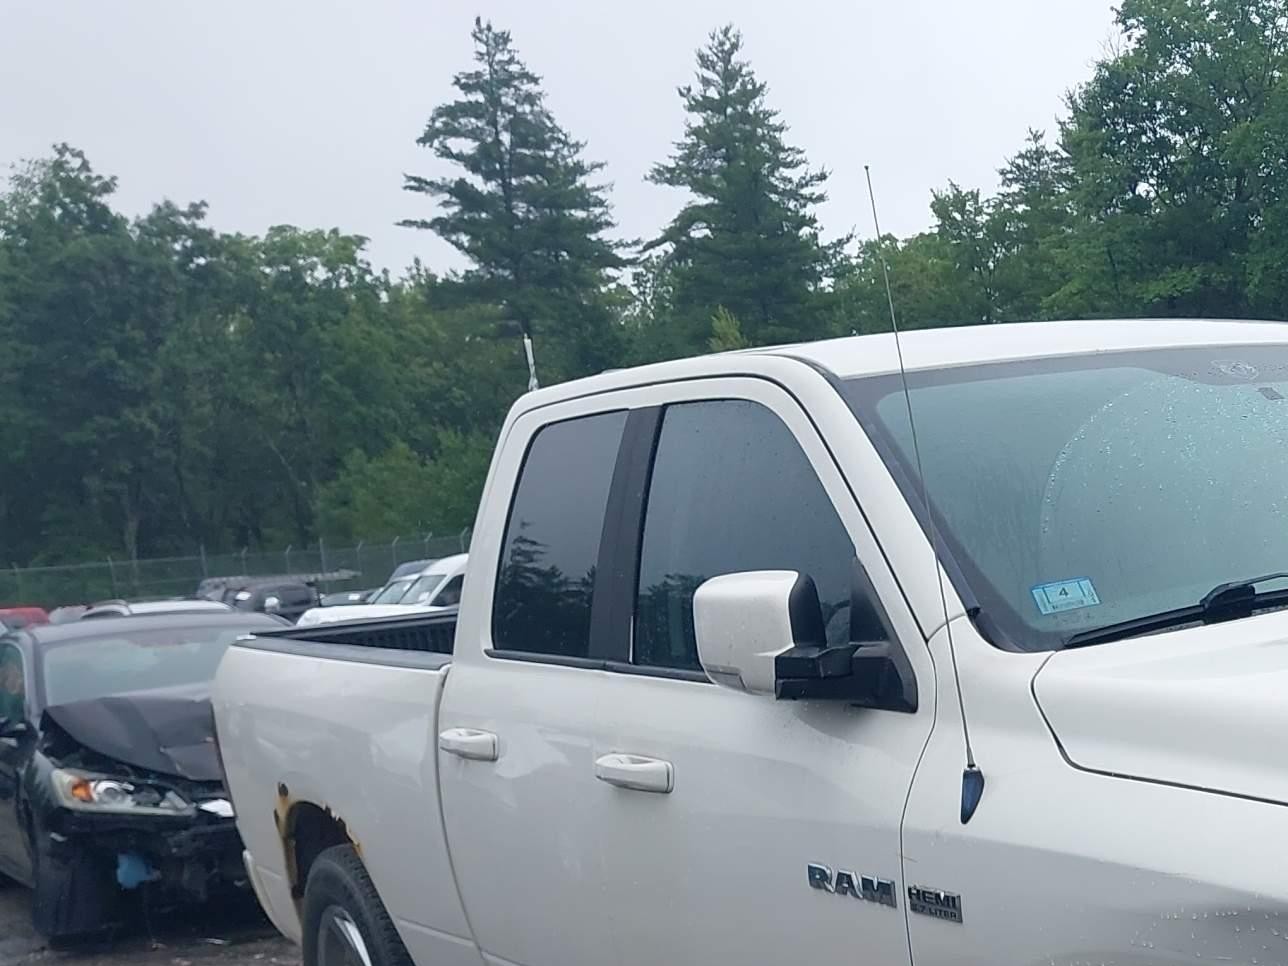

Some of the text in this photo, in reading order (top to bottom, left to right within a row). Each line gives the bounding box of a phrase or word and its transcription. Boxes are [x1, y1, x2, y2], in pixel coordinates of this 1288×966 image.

[1059, 586, 1069, 597] 4
[807, 863, 897, 908] RAM
[908, 885, 958, 908] HEMI
[928, 907, 957, 922] LITER
